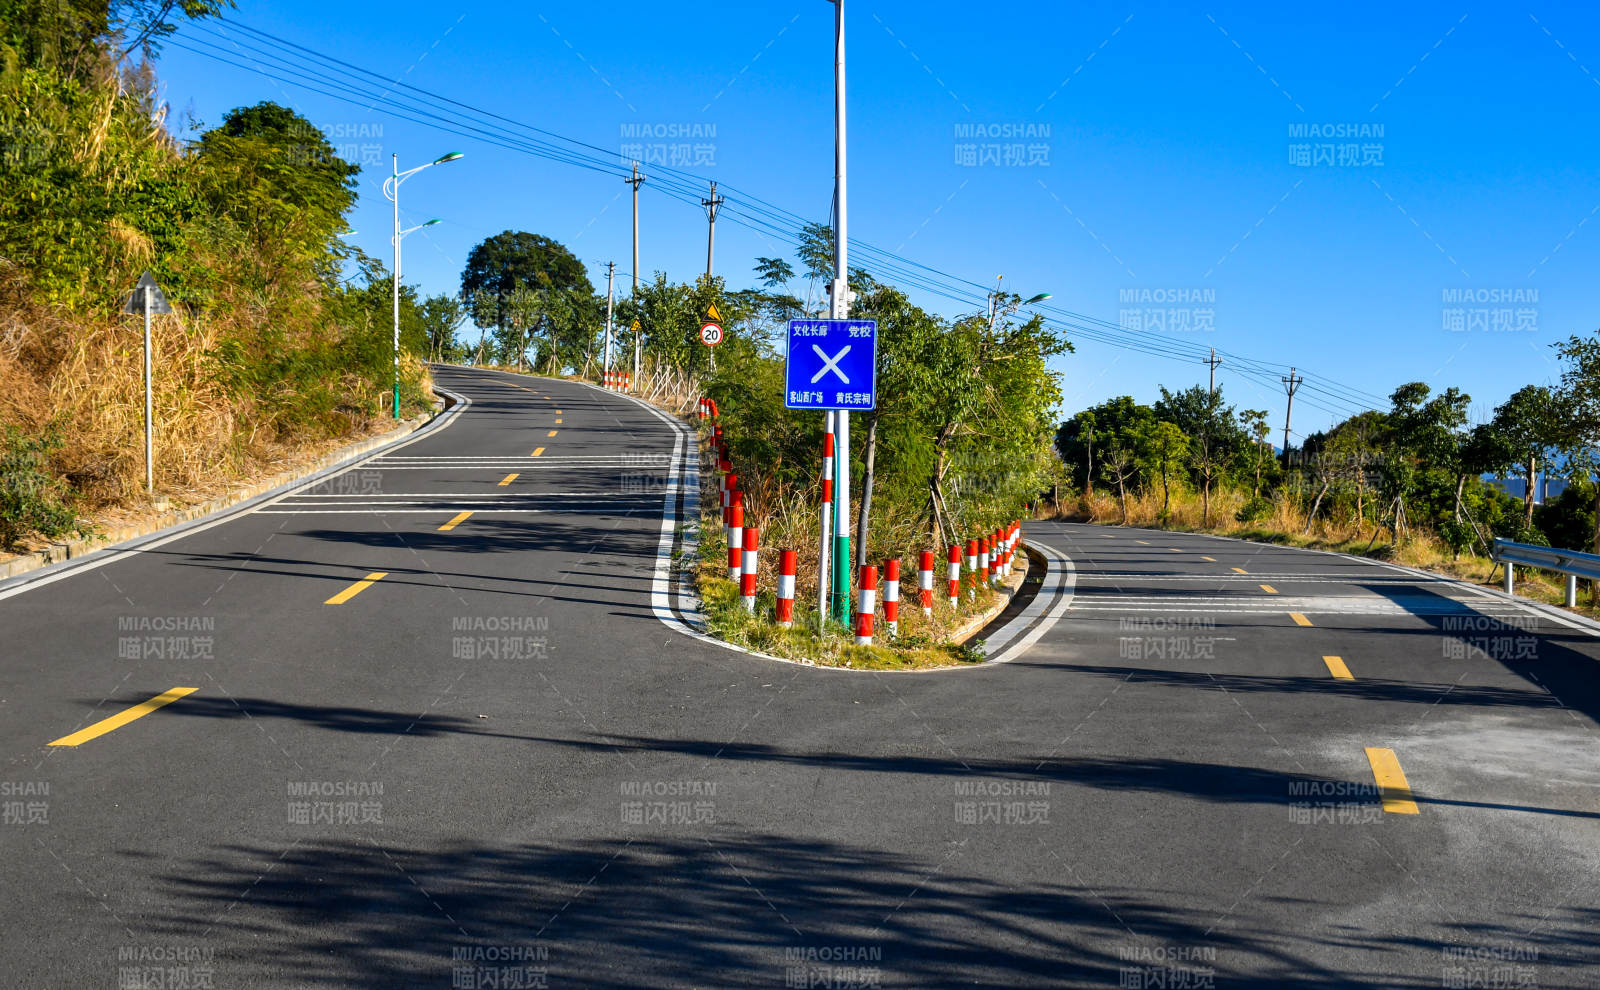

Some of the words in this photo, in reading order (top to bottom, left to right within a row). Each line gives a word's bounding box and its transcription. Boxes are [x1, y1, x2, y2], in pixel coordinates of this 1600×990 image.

[704, 329, 718, 341] 20
[793, 325, 828, 337] 文化长廊
[848, 325, 872, 338] 党校
[835, 391, 871, 405] 黄氏宗祠
